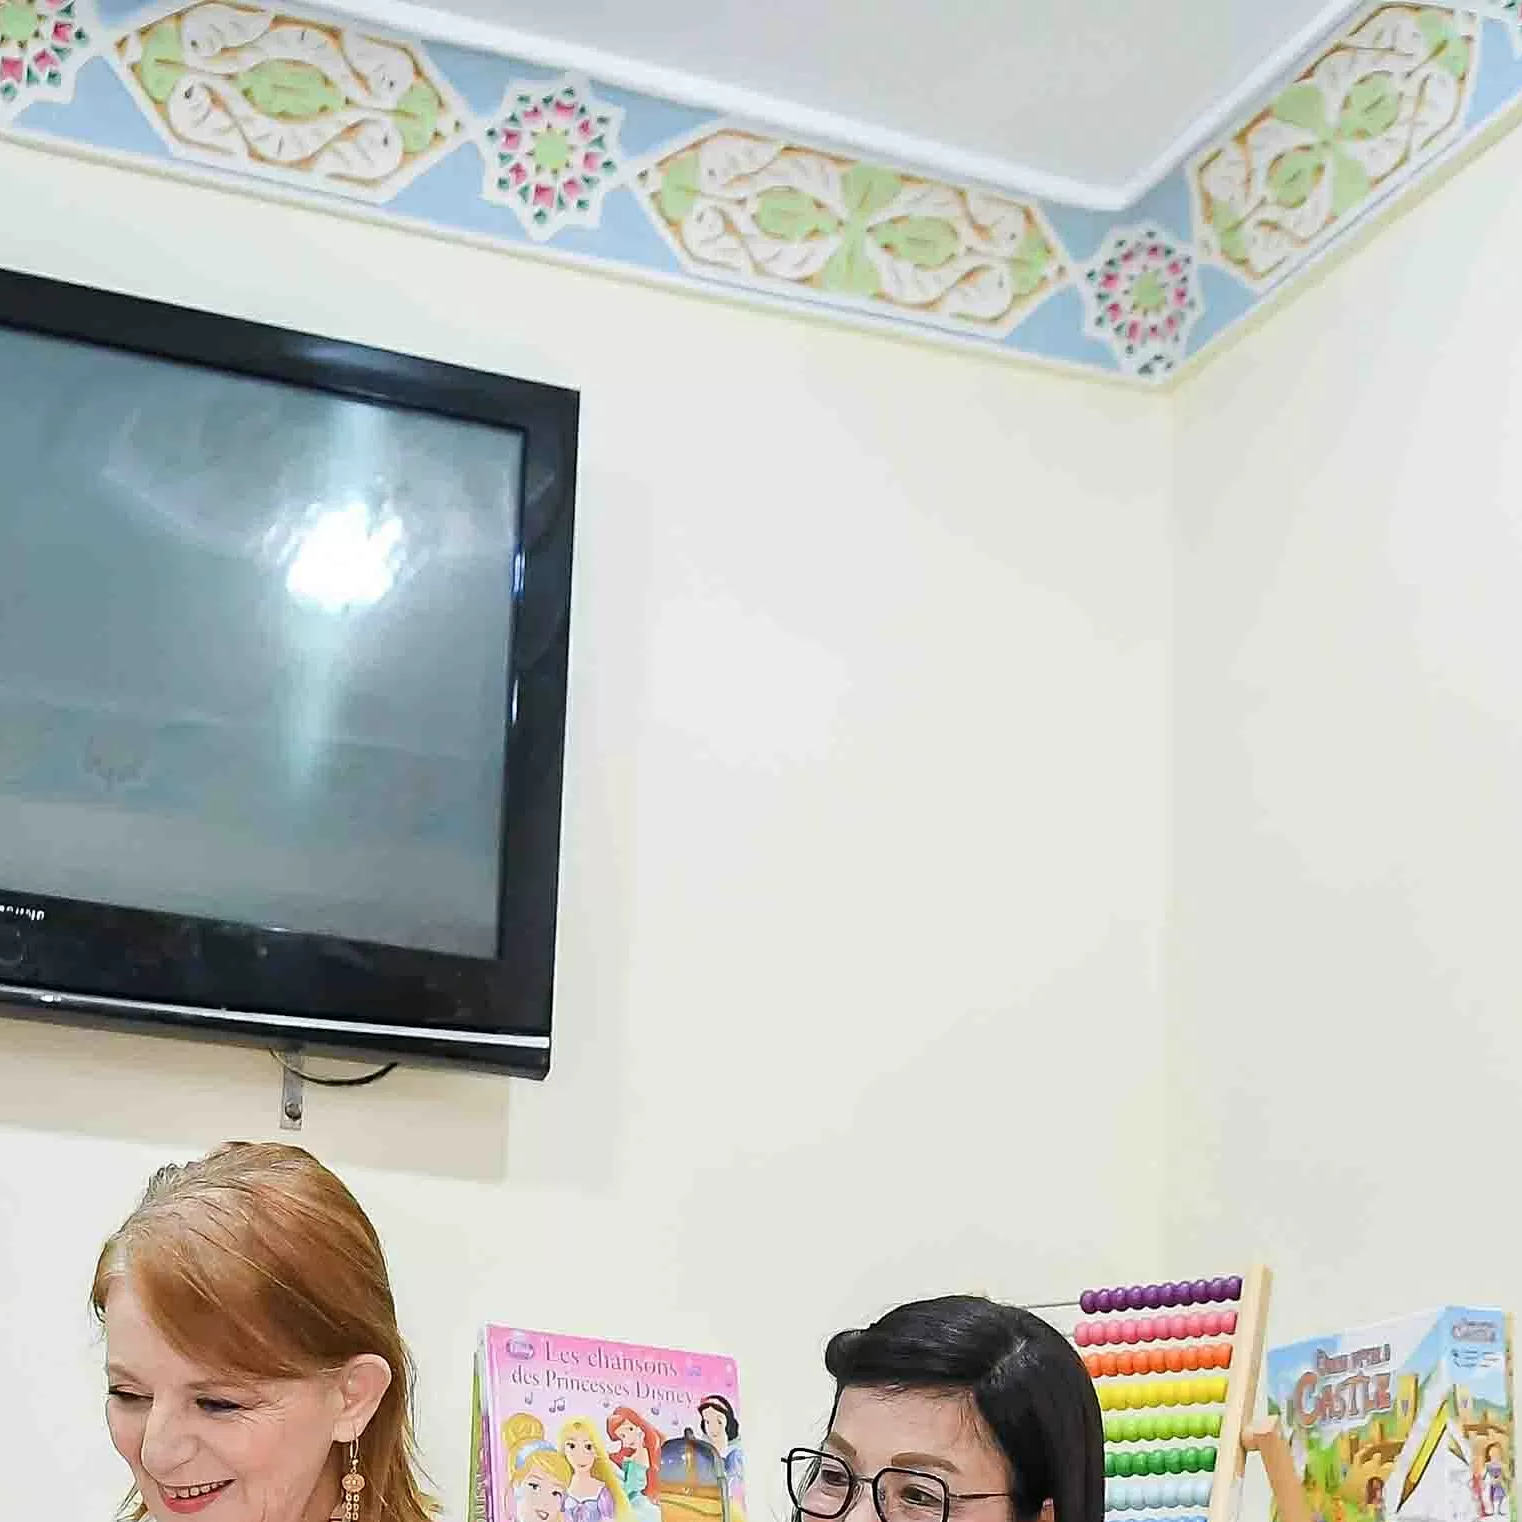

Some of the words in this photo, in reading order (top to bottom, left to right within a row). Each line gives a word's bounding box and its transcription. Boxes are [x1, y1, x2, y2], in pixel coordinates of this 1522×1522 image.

[545, 1341, 579, 1365] Les
[588, 1347, 678, 1377] chansons
[511, 1364, 540, 1386] des
[545, 1370, 631, 1397] Princesses
[636, 1380, 693, 1407] Disney
